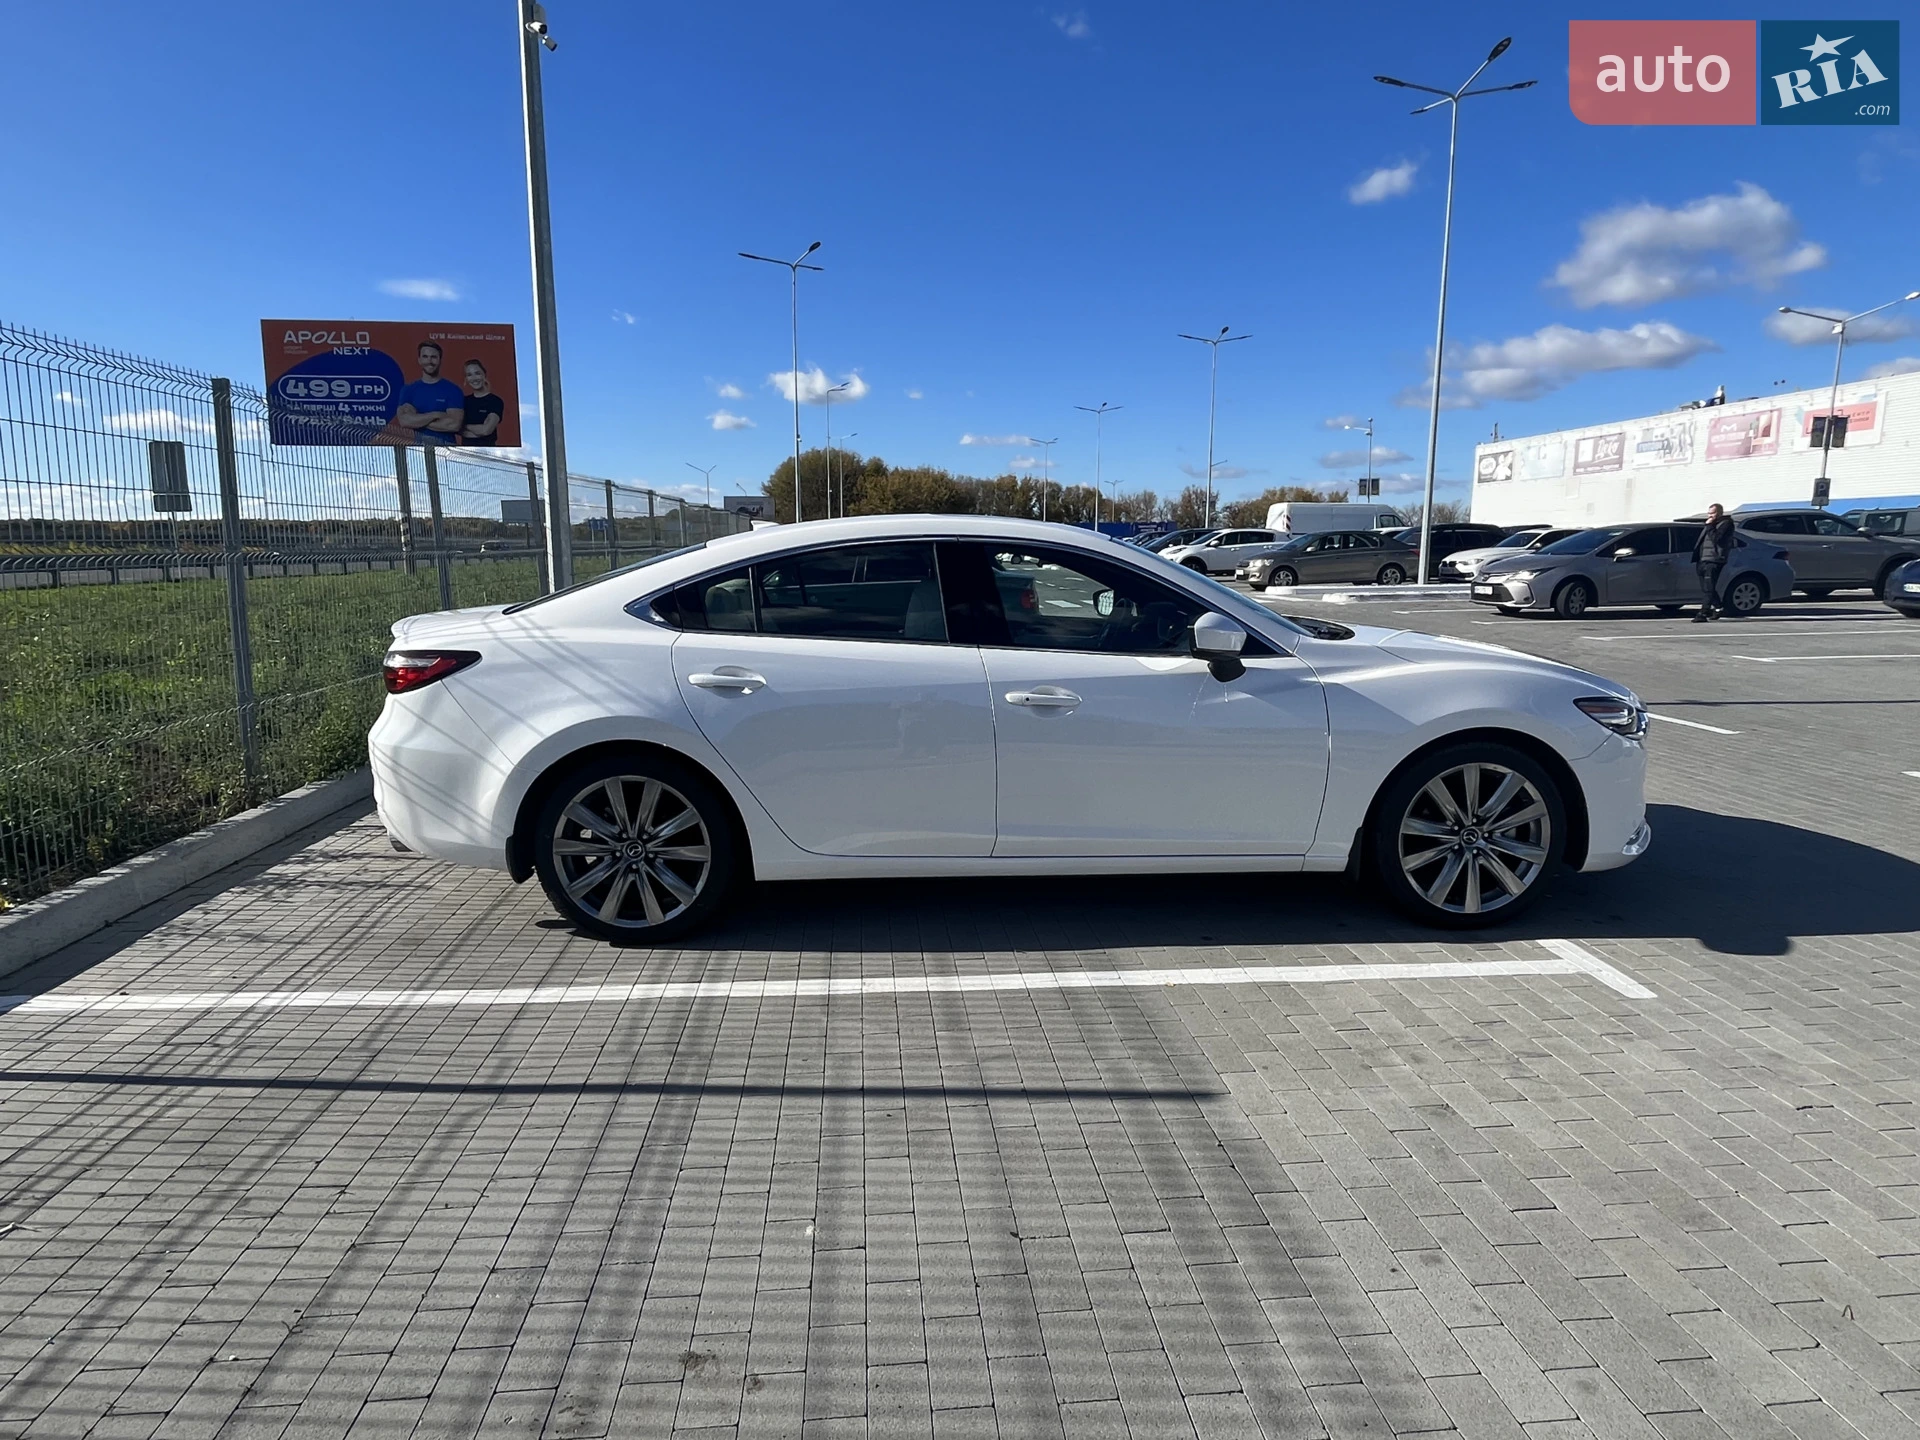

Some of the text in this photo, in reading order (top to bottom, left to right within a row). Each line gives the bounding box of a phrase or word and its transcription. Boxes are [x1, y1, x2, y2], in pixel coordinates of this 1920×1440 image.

[283, 329, 370, 345] APOLLO
[333, 346, 371, 356] NEXT
[286, 379, 384, 398] 499 ГРН
[338, 402, 350, 413] 4
[352, 404, 386, 412] ТИЖНІ
